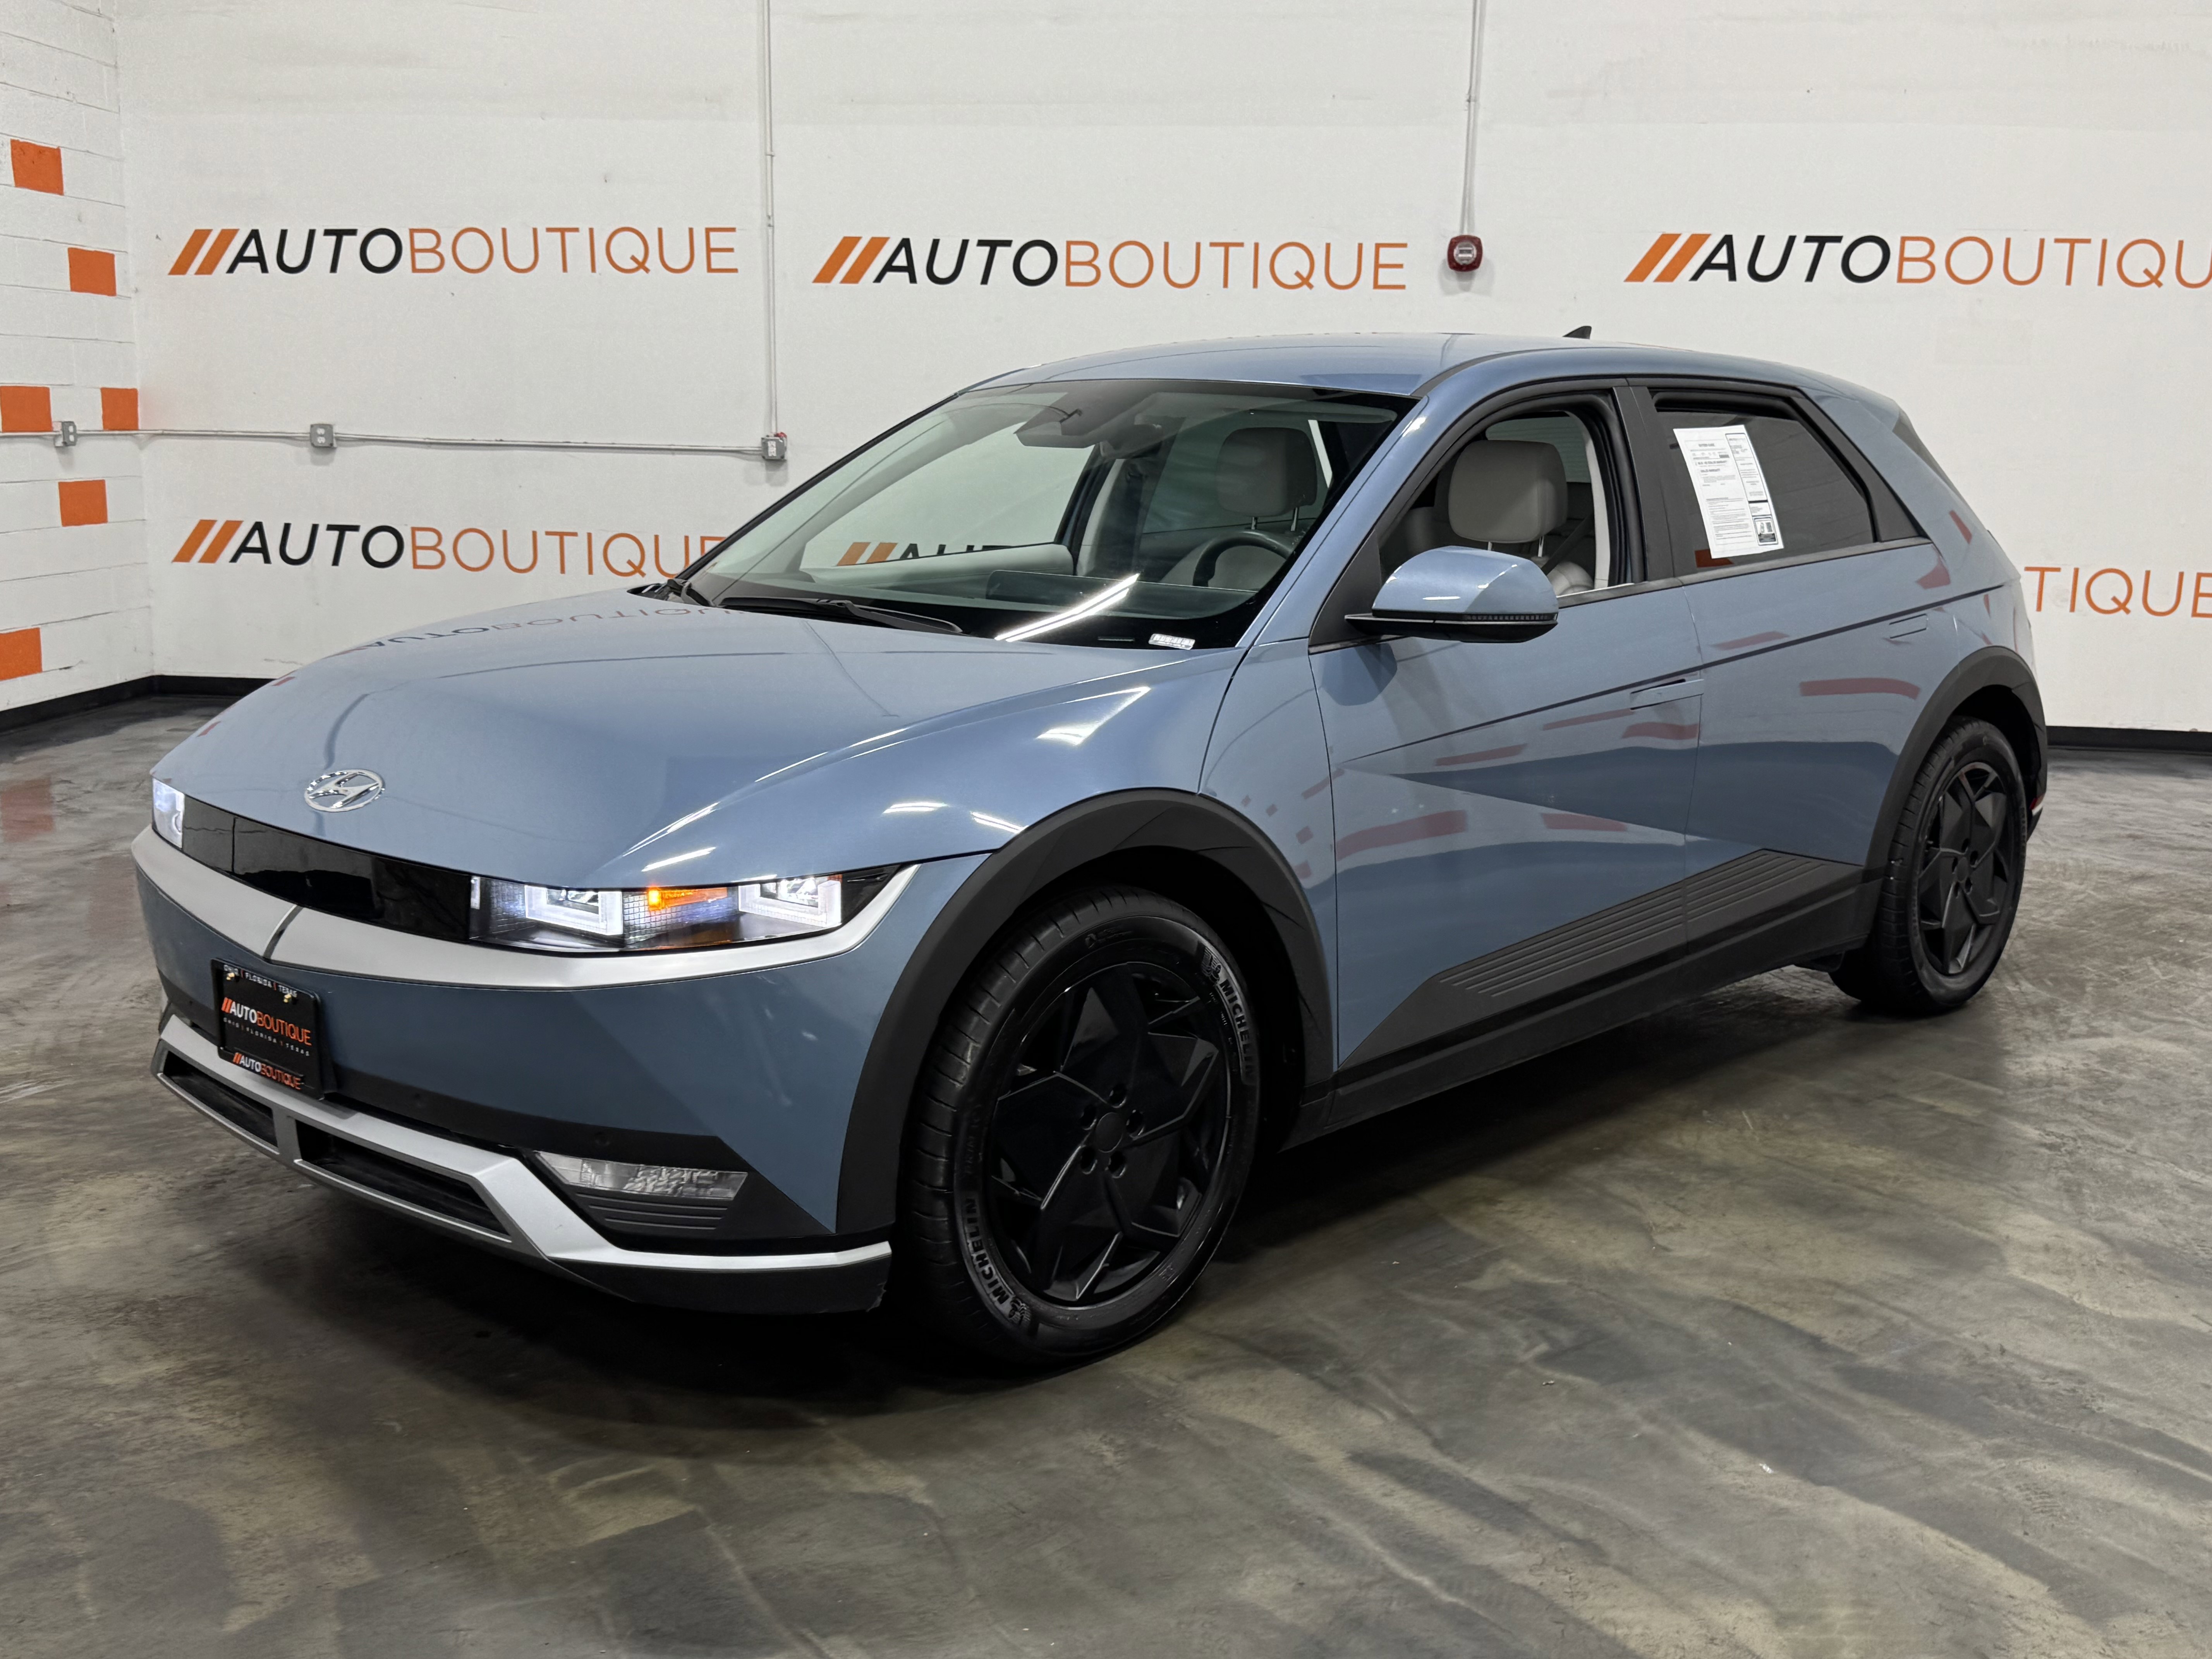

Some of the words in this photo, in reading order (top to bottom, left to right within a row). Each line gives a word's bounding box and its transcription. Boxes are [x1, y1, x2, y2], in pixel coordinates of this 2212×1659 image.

[225, 227, 738, 275] AUTOBOUTIQUE
[872, 237, 1408, 290] AUTOBOUTIQUE
[229, 1001, 312, 1046] AUTOBOUTIQUE
[1219, 978, 1255, 1079] MICHELIN
[239, 1055, 302, 1091] AUTOBOUTIQUE
[965, 1198, 1009, 1305] MICHELIN
